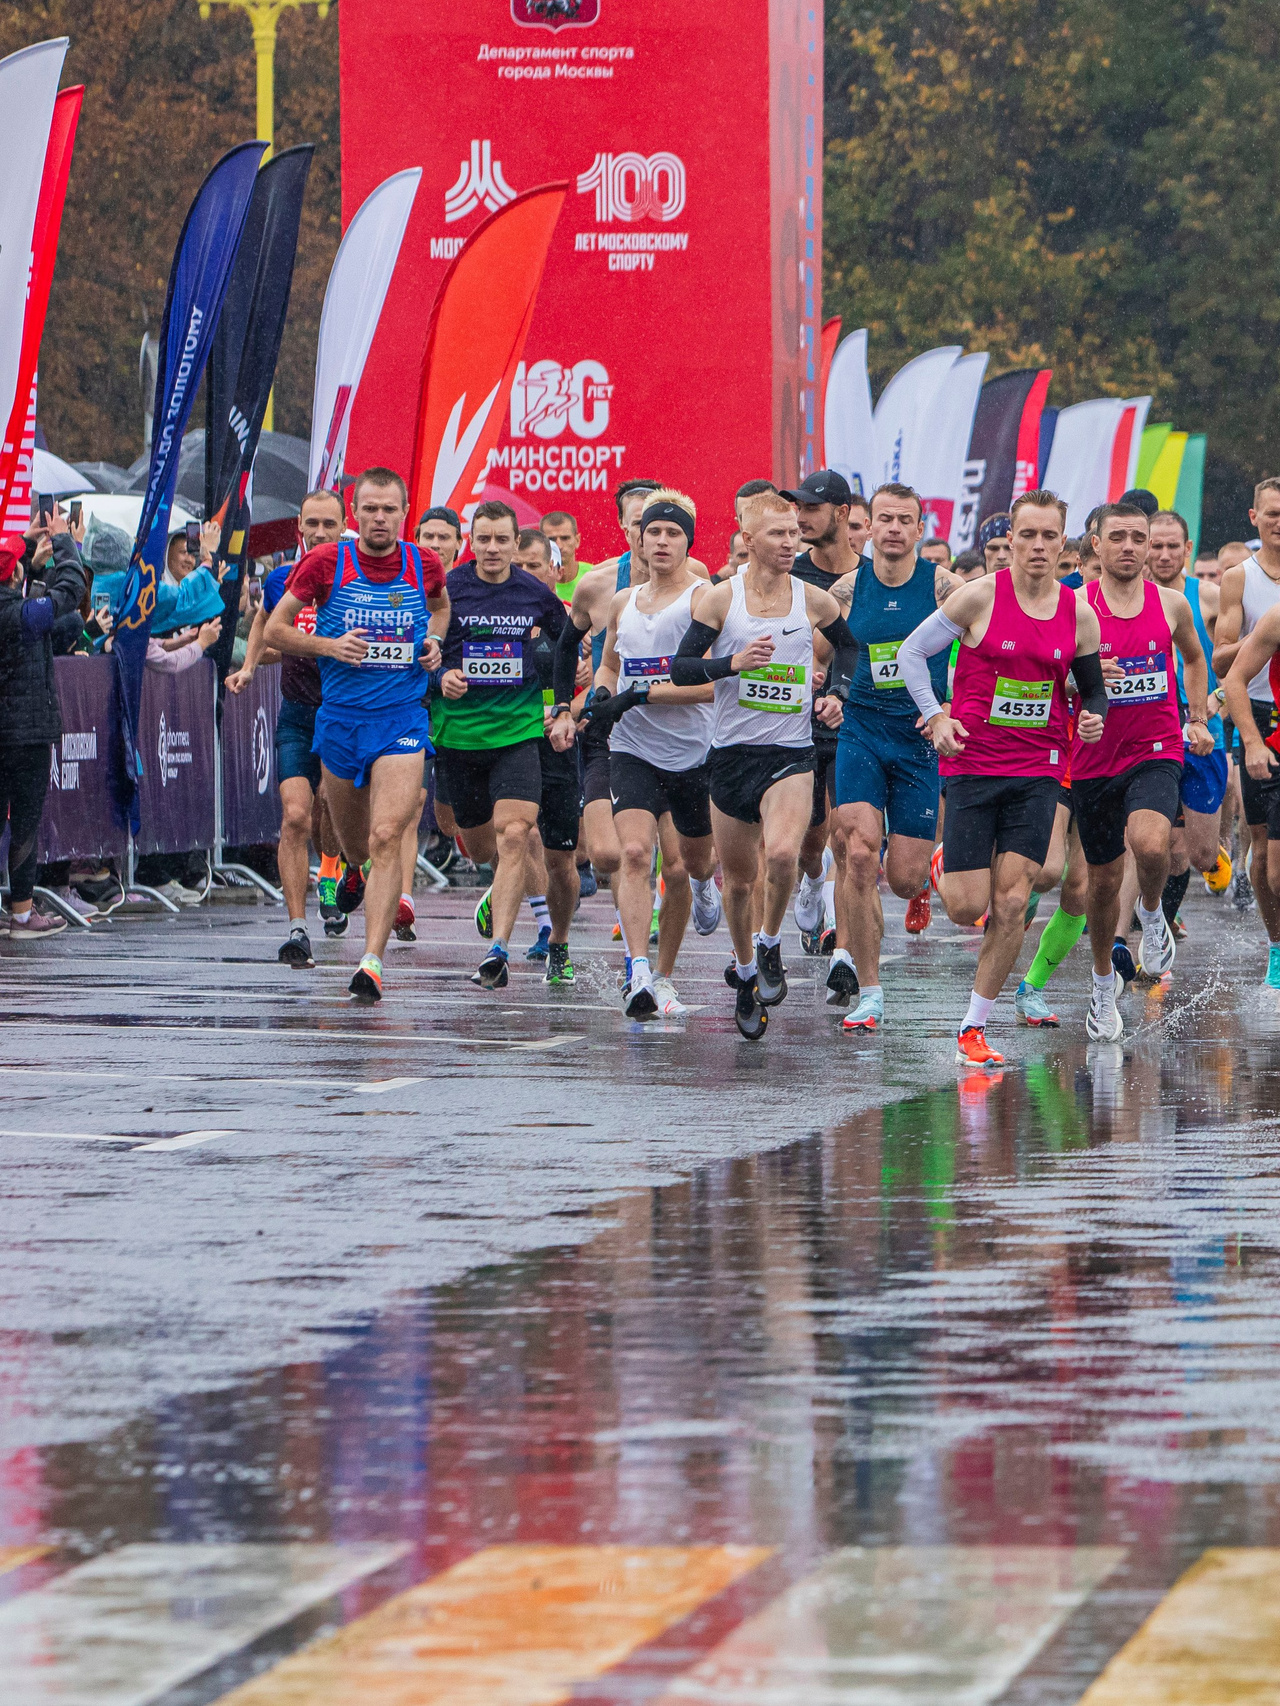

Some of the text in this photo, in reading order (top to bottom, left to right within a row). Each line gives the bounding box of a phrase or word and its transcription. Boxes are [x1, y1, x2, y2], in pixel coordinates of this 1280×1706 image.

[477, 44, 634, 62] Департамент спорта
[498, 65, 613, 81] города Москвы
[577, 151, 686, 222] 100
[575, 233, 689, 251] ЛЕТ МОСКОВСКОМУ
[608, 253, 655, 271] СПОРТУ
[586, 384, 615, 399] ЛЕТ
[490, 446, 627, 469] МИНСПОРТ
[509, 468, 608, 492] РОССИИ
[458, 615, 534, 627] УРАЛХИМ
[492, 626, 526, 636] FACTORY
[468, 661, 512, 675] 6026
[878, 663, 900, 678] 47
[745, 683, 792, 702] 3525
[1110, 677, 1156, 695] 6243
[998, 702, 1047, 717] 4533
[61, 762, 80, 790] СПОРТ
